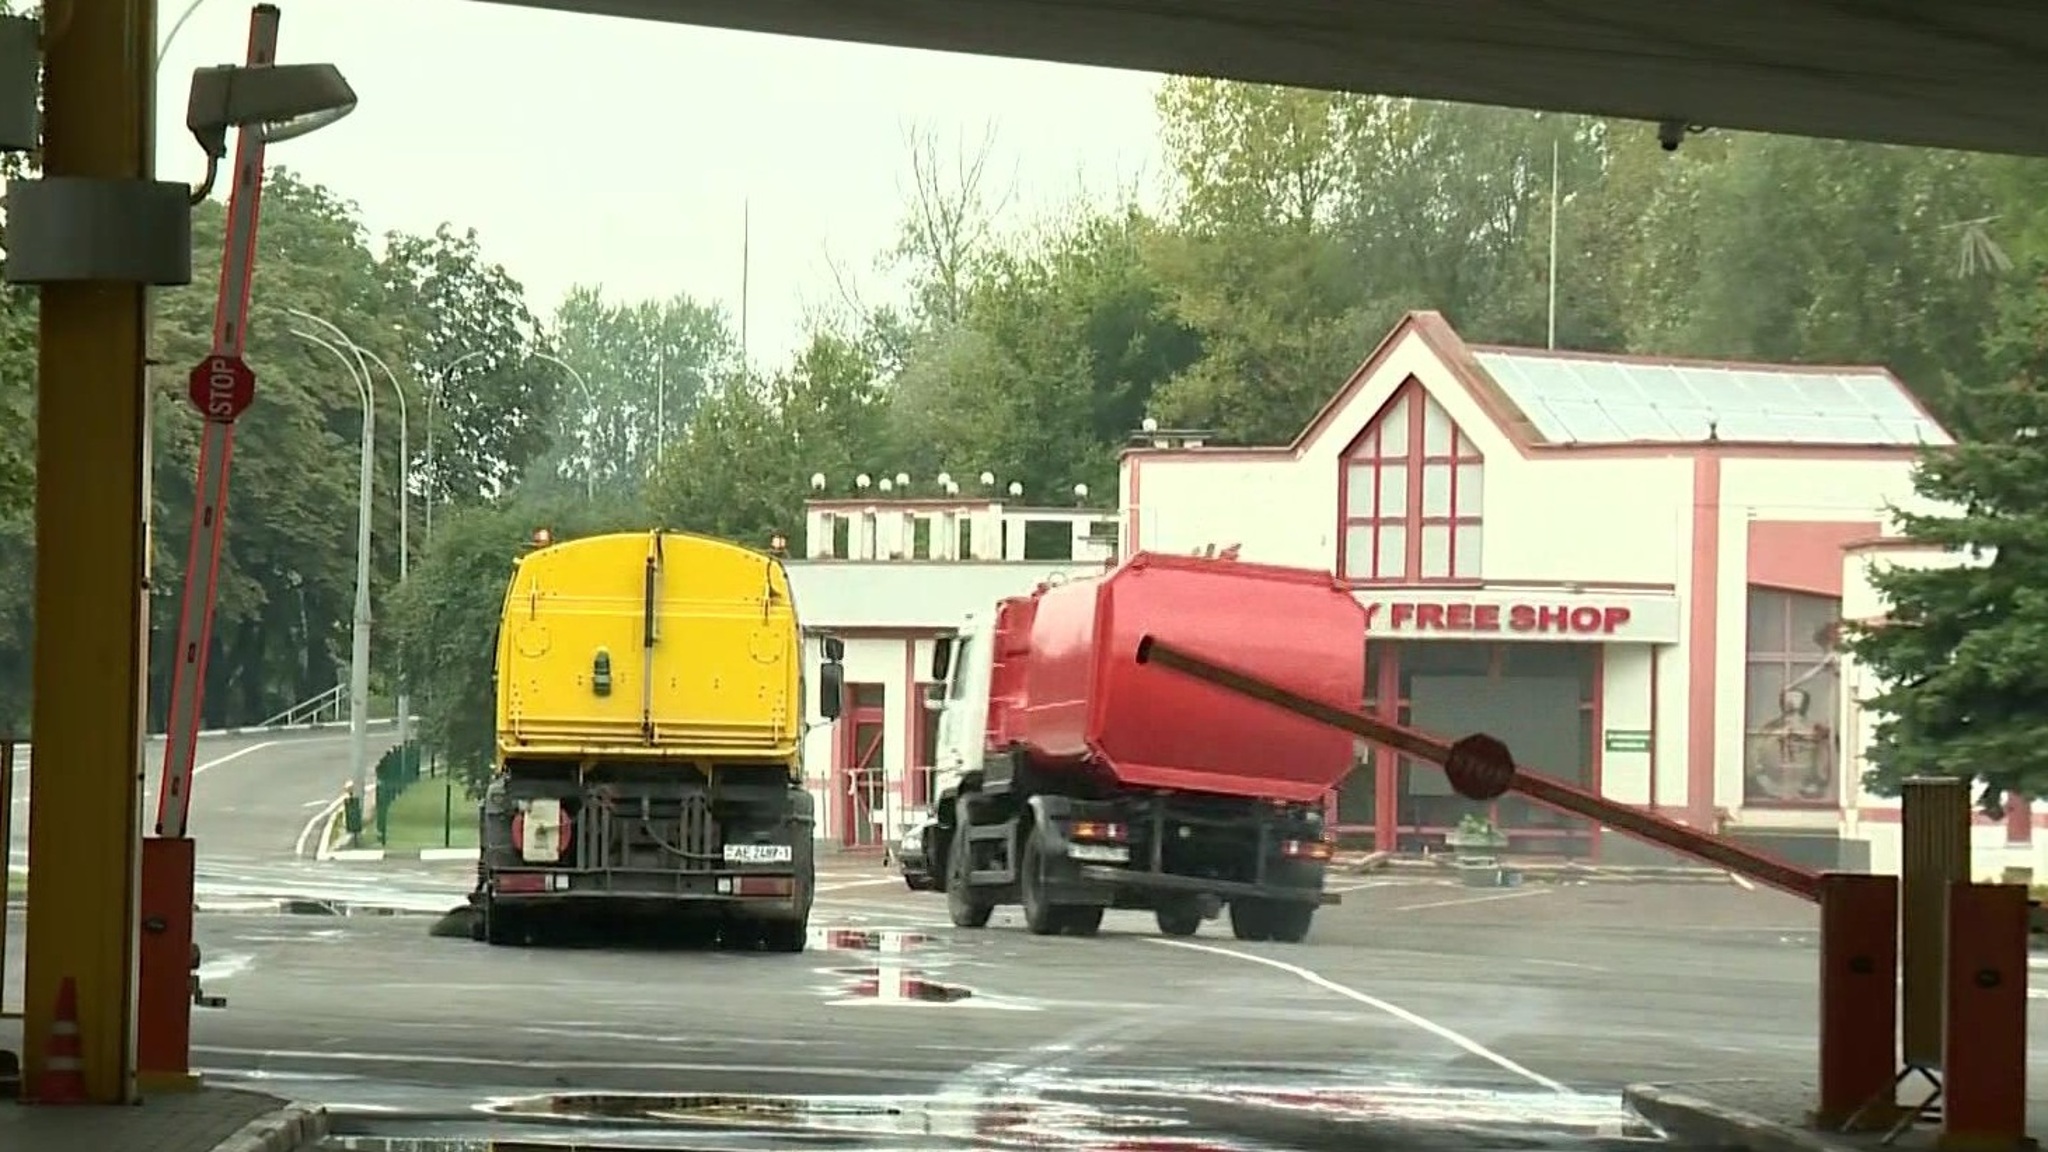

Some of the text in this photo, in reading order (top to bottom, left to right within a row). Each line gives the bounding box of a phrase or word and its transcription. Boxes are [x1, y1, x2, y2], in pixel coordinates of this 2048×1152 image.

[208, 359, 235, 415] STOP
[1390, 603, 1500, 631] FREE
[1509, 604, 1631, 633] SHOP
